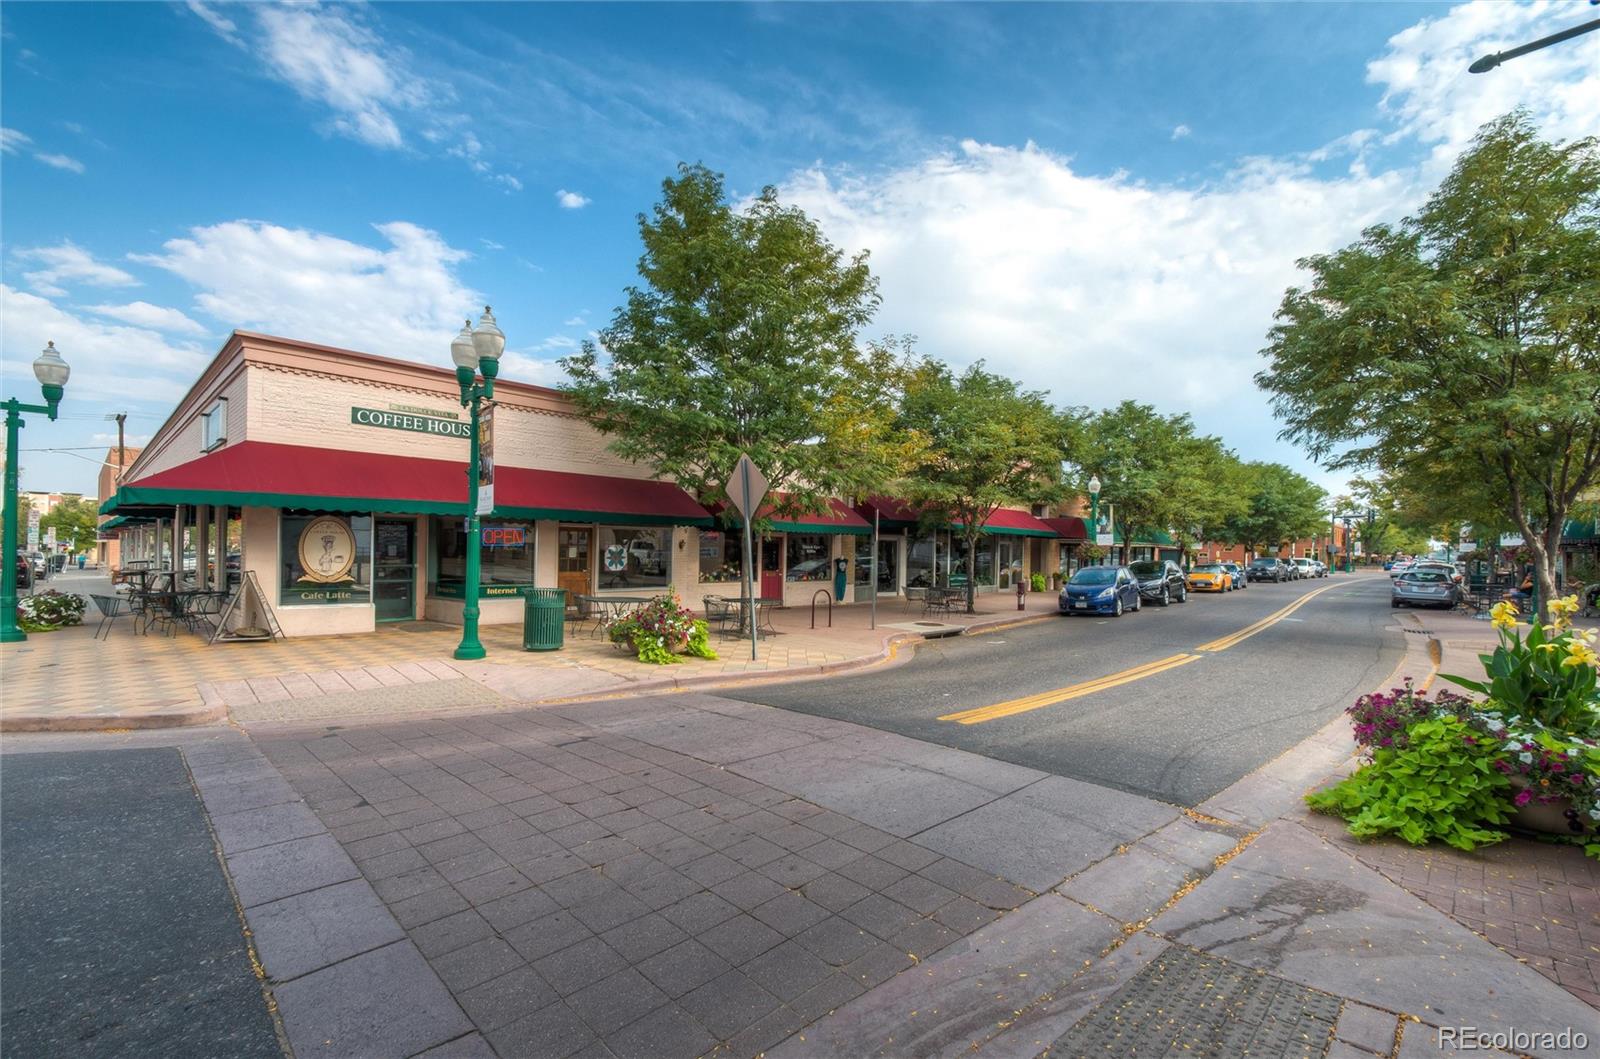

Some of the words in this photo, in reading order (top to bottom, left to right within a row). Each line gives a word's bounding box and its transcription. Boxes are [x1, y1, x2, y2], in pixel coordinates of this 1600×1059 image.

[357, 409, 423, 430] COFFEE
[428, 420, 471, 436] HOUS
[484, 529, 523, 544] OPEN
